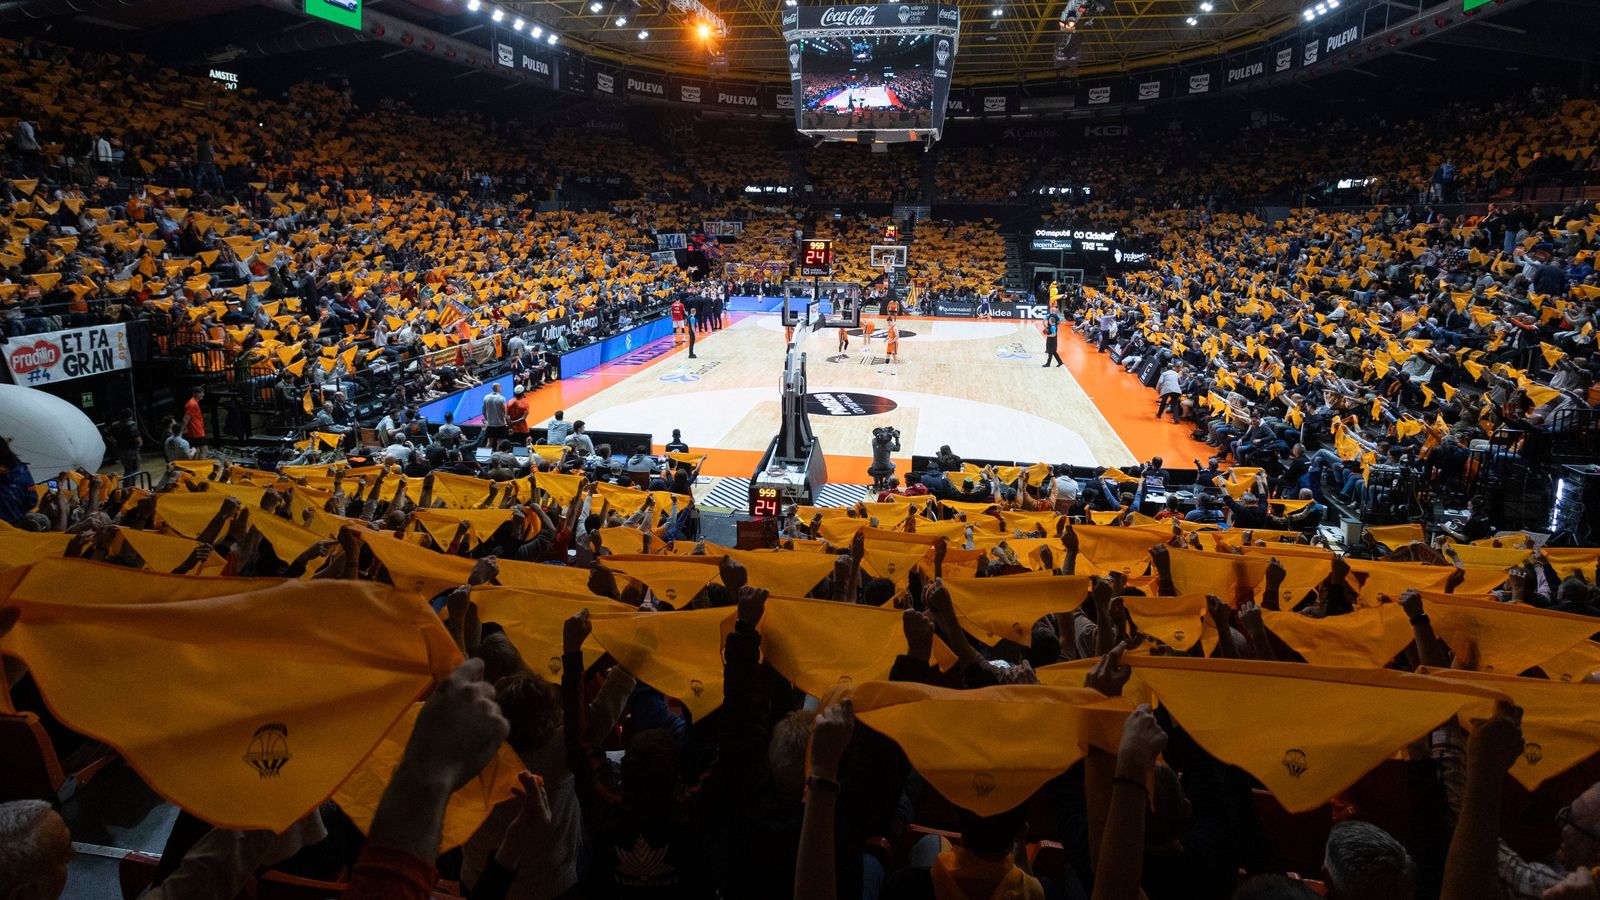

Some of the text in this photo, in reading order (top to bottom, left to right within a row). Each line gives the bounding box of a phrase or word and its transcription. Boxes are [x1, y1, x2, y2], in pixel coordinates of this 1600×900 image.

[821, 6, 878, 26] Coca-Cola
[1326, 26, 1357, 53] PULEVA
[522, 55, 549, 75] PULEVA
[1228, 62, 1263, 82] PULEVA
[627, 78, 663, 95] PULEVA
[718, 93, 757, 106] PULEVA
[806, 251, 824, 264] 24
[1016, 305, 1048, 318] TKE
[61, 329, 109, 354] ET FA
[12, 347, 55, 370] pradillo
[63, 348, 114, 377] GRAN
[28, 368, 51, 382] #4
[755, 500, 776, 515] 24
